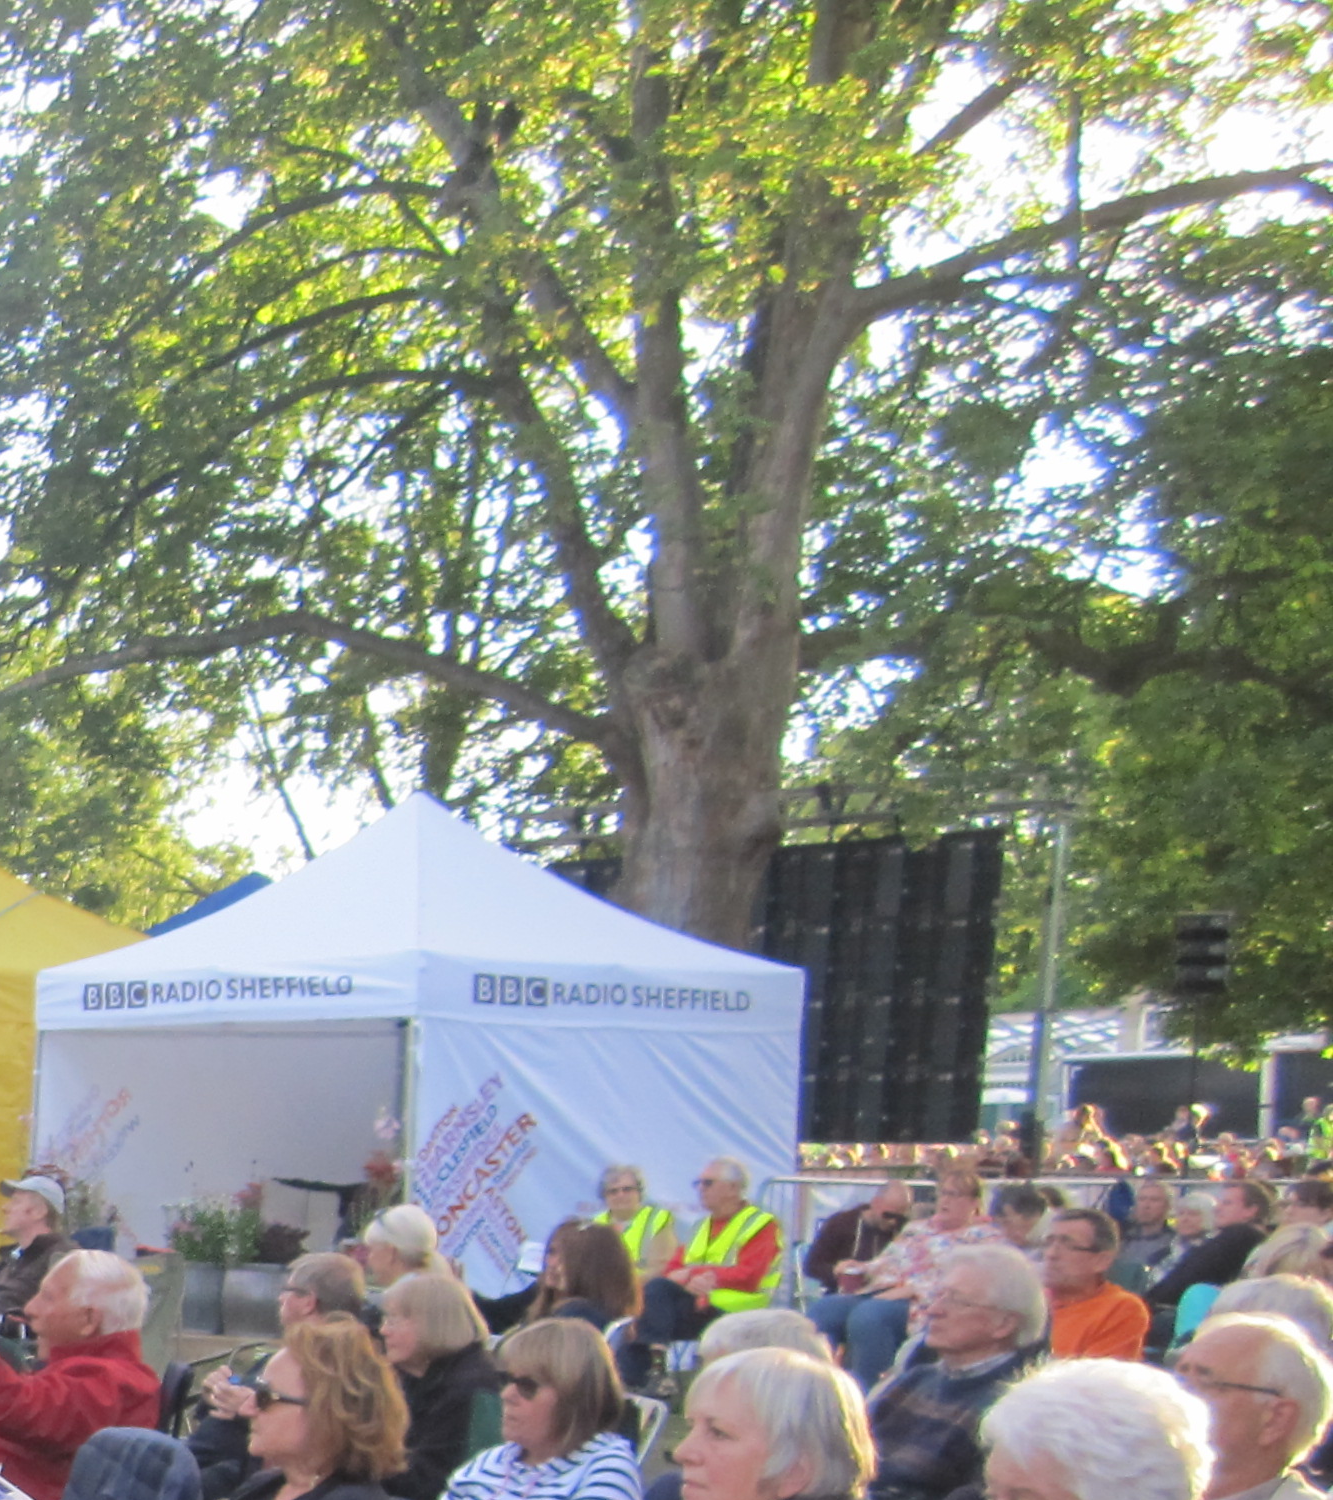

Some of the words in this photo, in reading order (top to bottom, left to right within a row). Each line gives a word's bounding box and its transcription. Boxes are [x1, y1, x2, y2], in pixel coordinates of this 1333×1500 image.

[83, 982, 149, 1011] BBC
[151, 981, 222, 1004] RADIO
[226, 975, 354, 1000] SHEFFIELD
[473, 973, 548, 1007] BBC
[552, 983, 627, 1006] RADIO
[632, 985, 751, 1012] SHEFFIELD
[436, 1113, 538, 1236] ONCASTER
